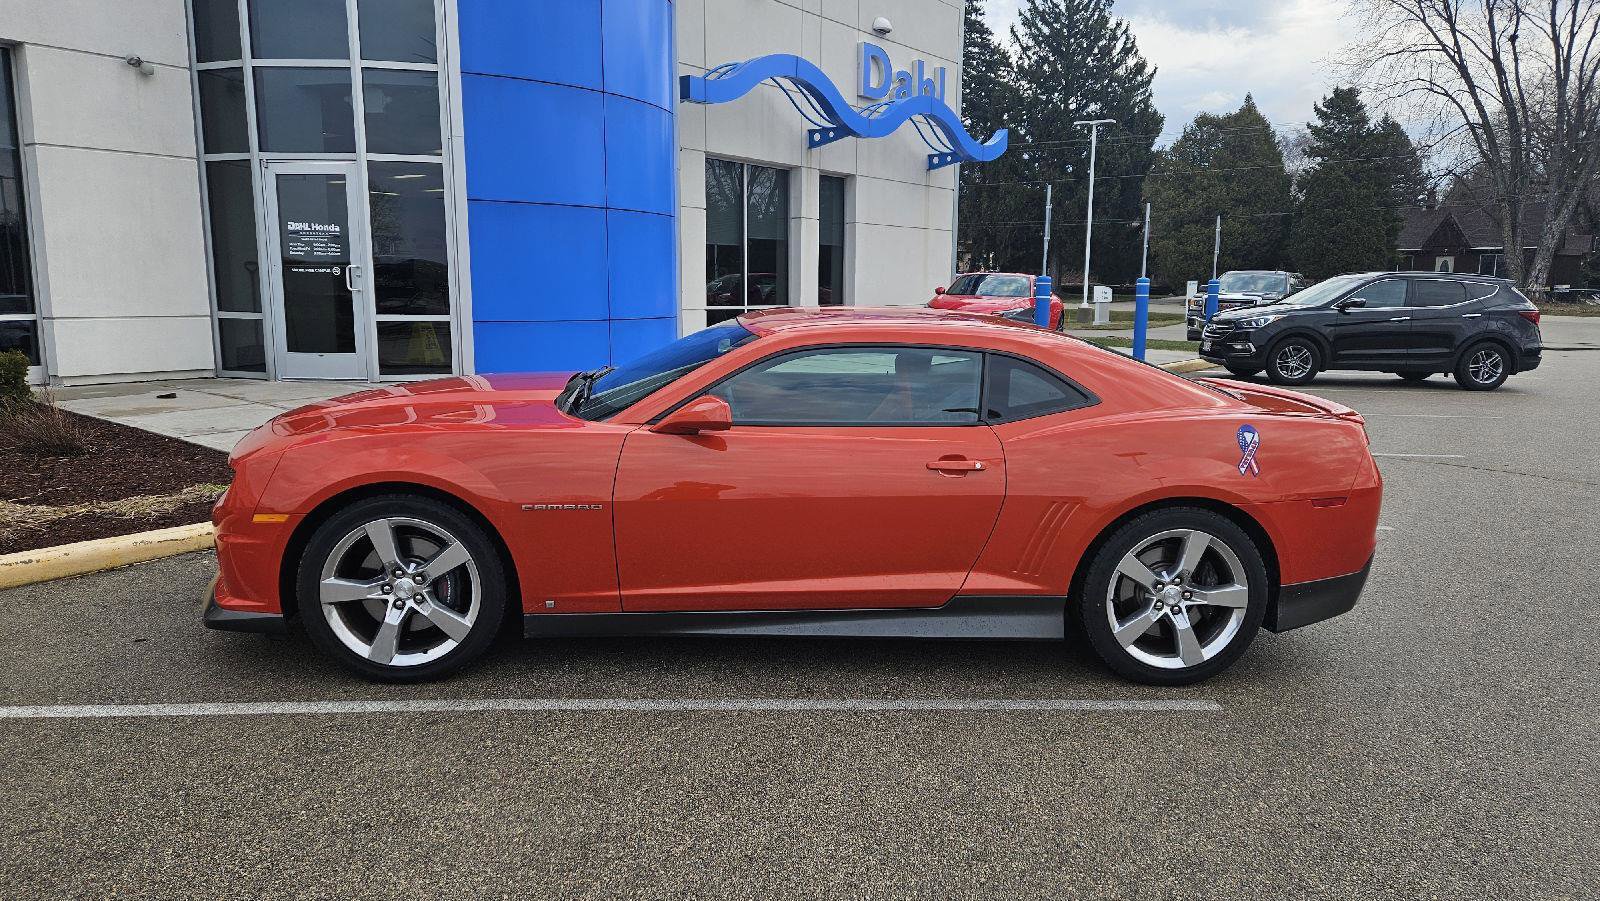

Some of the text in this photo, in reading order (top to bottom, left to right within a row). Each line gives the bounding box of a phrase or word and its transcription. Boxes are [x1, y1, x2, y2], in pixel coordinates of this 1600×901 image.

[858, 42, 945, 101] Dahl
[288, 222, 340, 231] DAHL Honda
